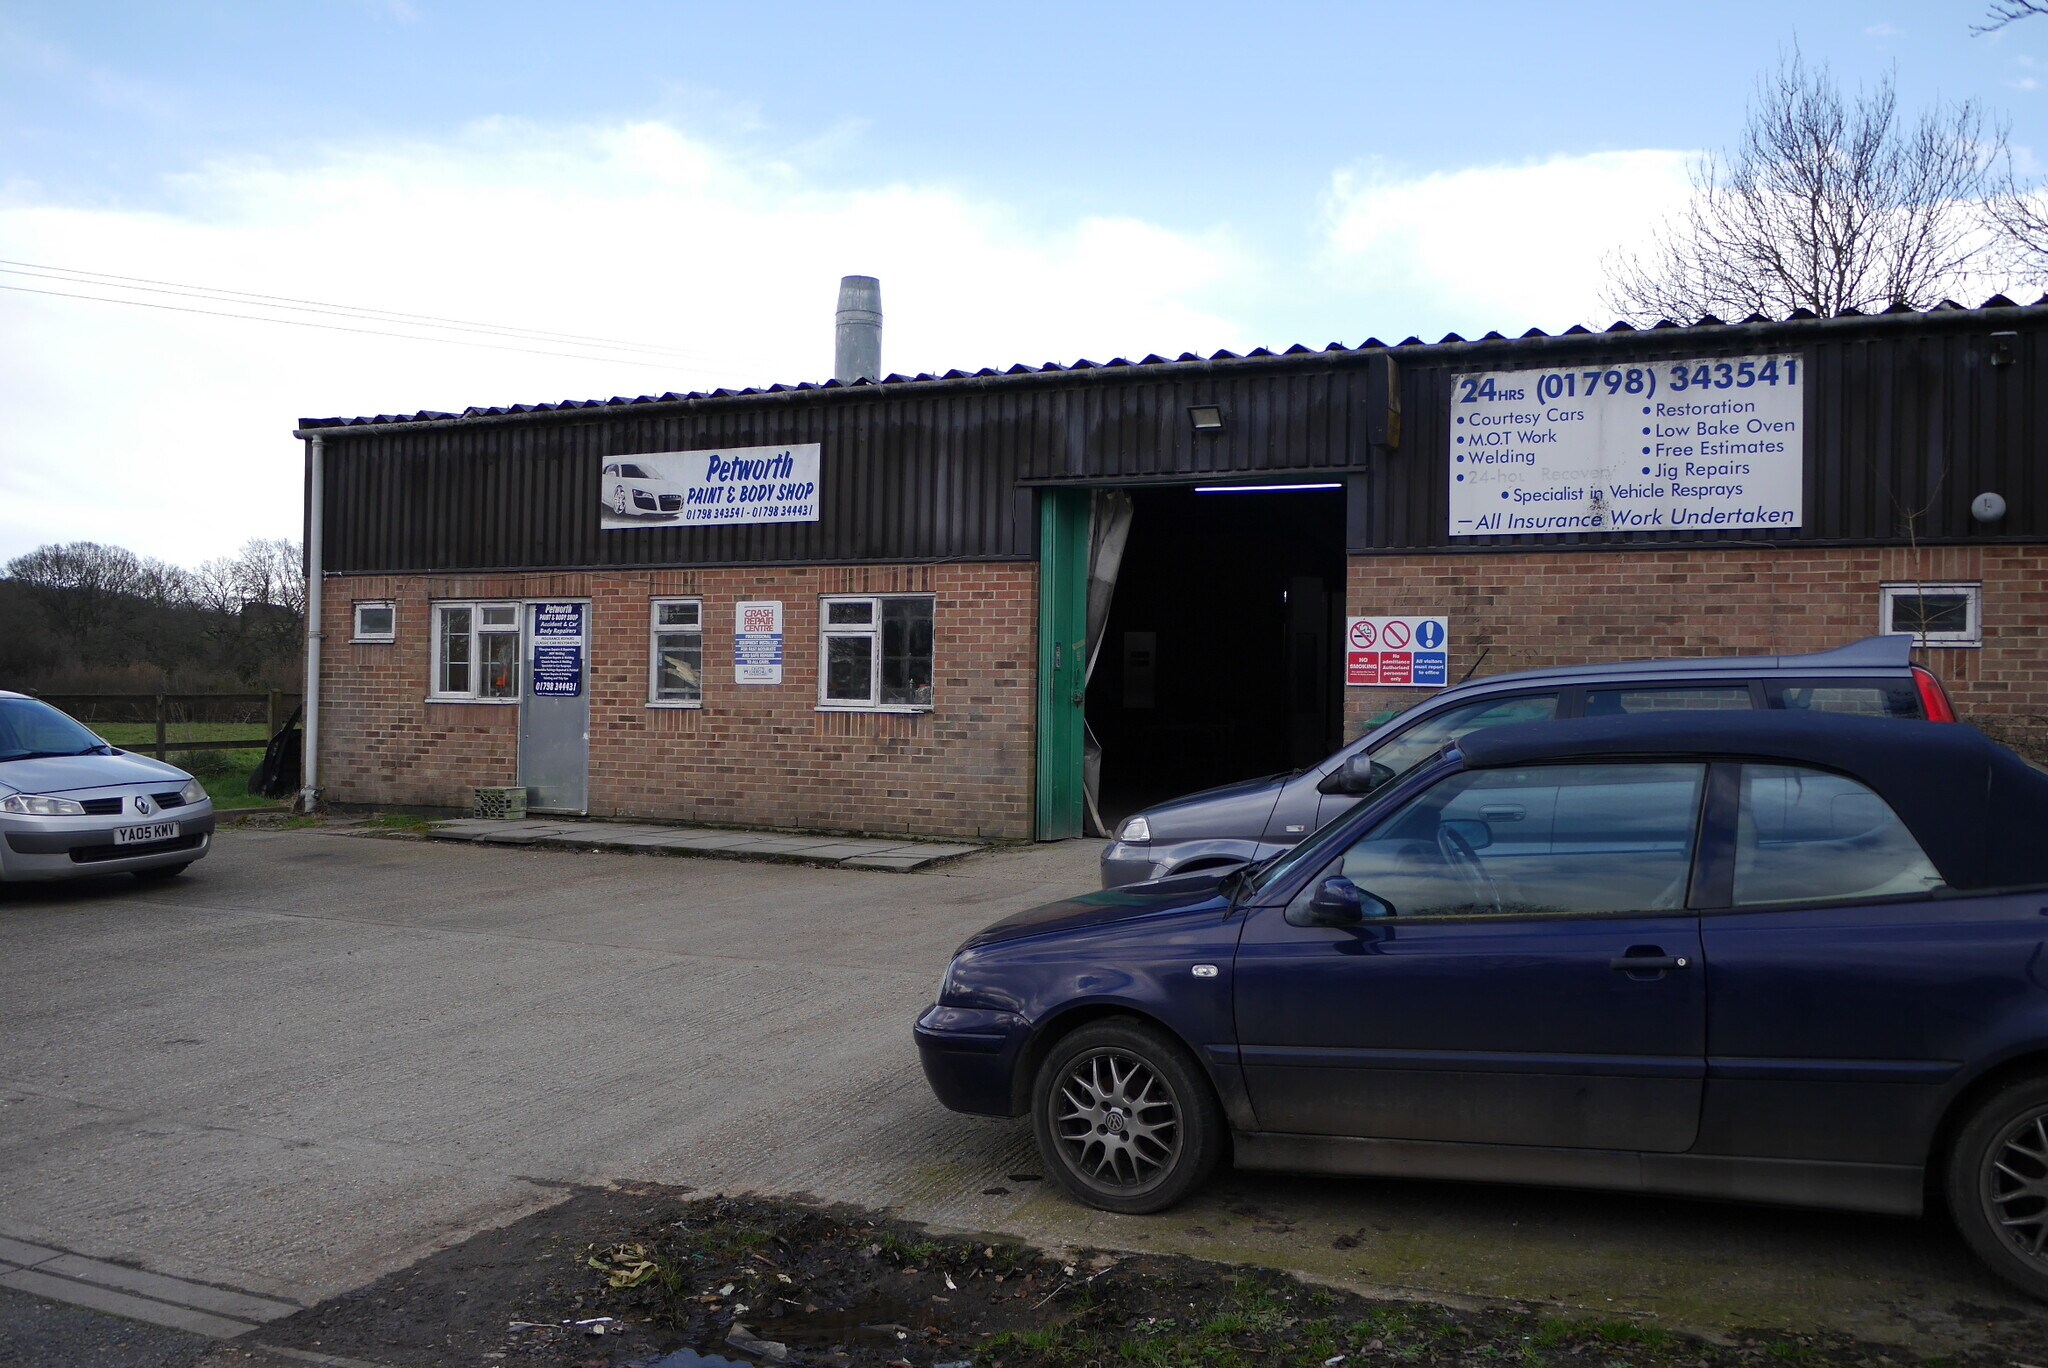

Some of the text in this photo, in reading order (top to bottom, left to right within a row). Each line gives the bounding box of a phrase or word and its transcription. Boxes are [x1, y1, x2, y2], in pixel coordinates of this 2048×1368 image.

[1537, 368, 1656, 405] (01798)
[1669, 361, 1796, 392] 343541
[1469, 408, 1584, 427] Courtesy Cars
[1656, 400, 1755, 417] Restoration
[1656, 419, 1795, 438] Low Bake Oven
[1468, 429, 1557, 447] M.O.T Work
[1656, 439, 1784, 457] Free Estimates
[706, 451, 794, 482] Petworth
[1468, 451, 1535, 466] Welding
[1655, 461, 1749, 480] Jig Repairs
[687, 482, 814, 504] PAINT & BODY SHOP
[1513, 483, 1742, 506] Specialist in Vehicle Resprays
[687, 509, 711, 520] 01798
[714, 507, 744, 518] 343541
[752, 506, 778, 517] 01798
[781, 505, 813, 516] 344431
[1508, 514, 1602, 528] Insurance
[1611, 508, 1662, 527] Work
[1671, 506, 1794, 524] Undertaken
[545, 604, 572, 613] Petworth
[536, 682, 576, 691] 01798 344431
[119, 824, 174, 841] YA05 KMV
